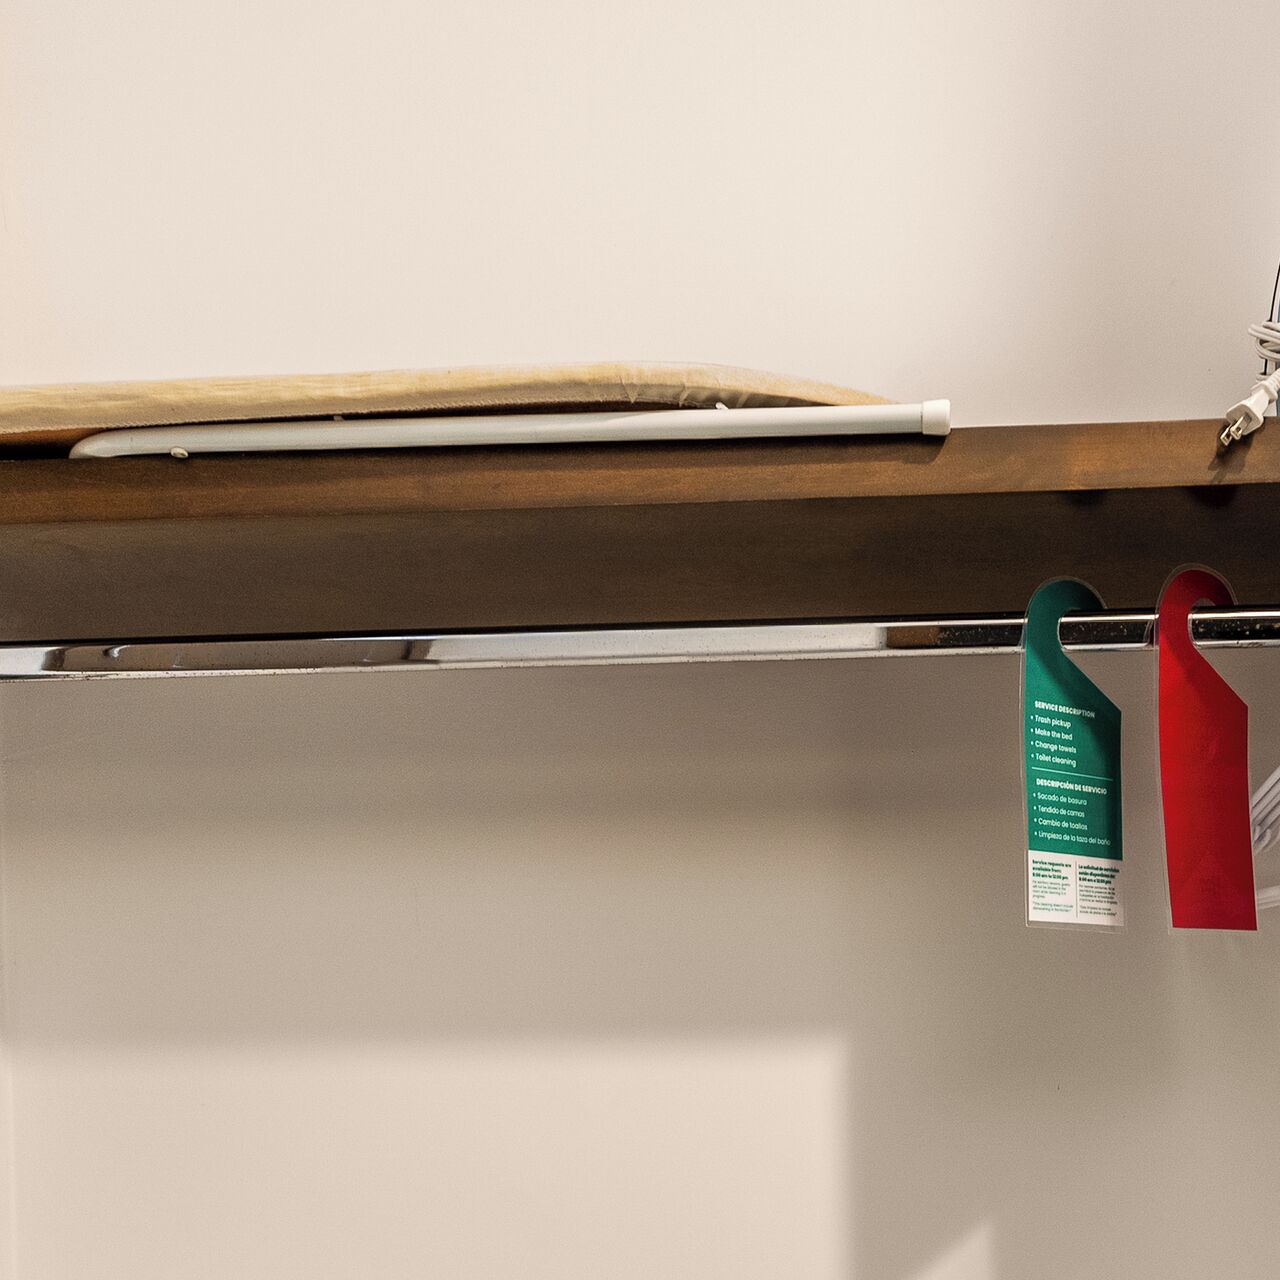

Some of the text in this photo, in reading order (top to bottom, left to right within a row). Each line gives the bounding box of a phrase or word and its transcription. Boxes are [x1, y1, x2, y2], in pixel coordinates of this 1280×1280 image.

[1034, 700, 1095, 718] SERVICE DESCRIPTION
[1035, 714, 1072, 729] Trash pickup
[1034, 727, 1073, 740] Make the bed
[1034, 740, 1077, 754] Change towels
[1035, 753, 1077, 768] Toilet cleaning
[1036, 778, 1107, 795] DESCRIPCIÓN DE SERVICIO
[1037, 791, 1088, 806] Sacado de basura
[1038, 804, 1085, 818] Tendido de camas
[1038, 817, 1088, 831] Cambio de toallas
[1038, 830, 1062, 840] Limpieza
[1062, 833, 1070, 841] de
[1070, 834, 1076, 842] la
[1076, 835, 1088, 843] taza
[1088, 836, 1097, 844] del
